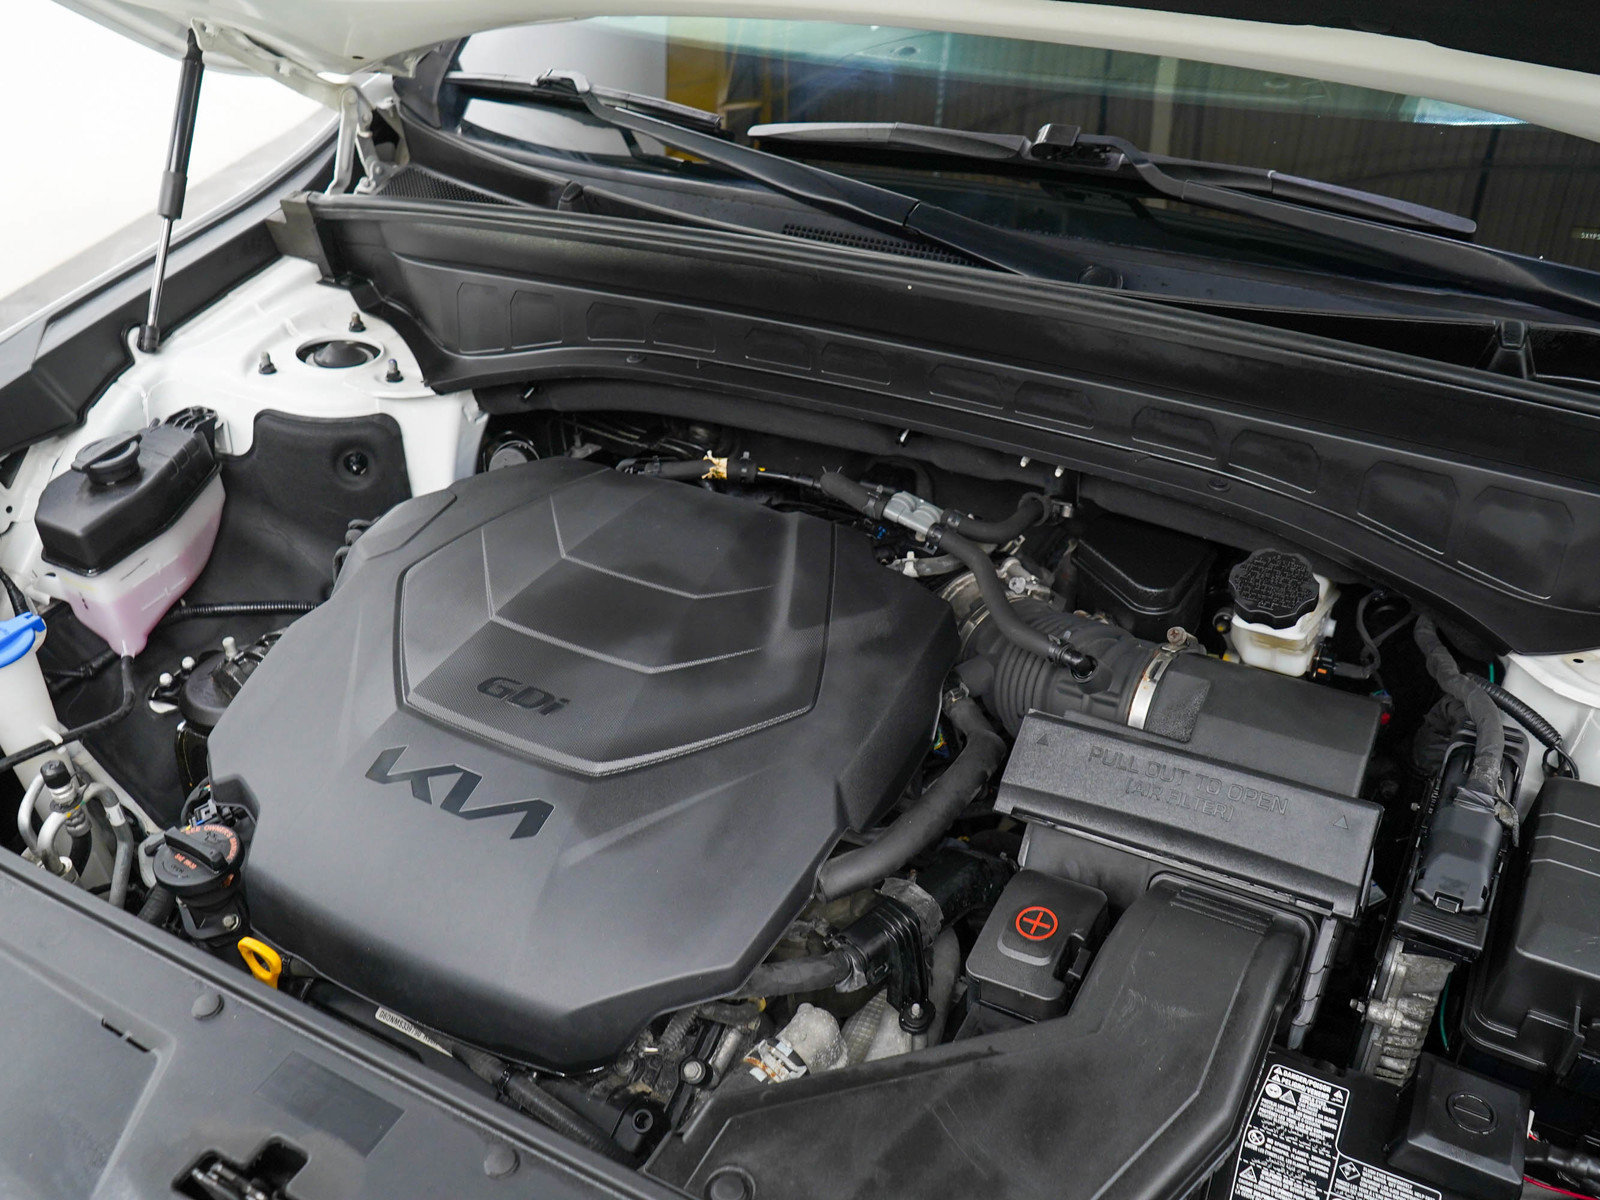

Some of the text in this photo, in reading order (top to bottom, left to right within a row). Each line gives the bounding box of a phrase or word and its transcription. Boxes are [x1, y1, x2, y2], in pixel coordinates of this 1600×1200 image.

[476, 676, 572, 716] GDi
[365, 744, 554, 840] KIA
[1088, 746, 1289, 816] PULL OUT TO OPEN
